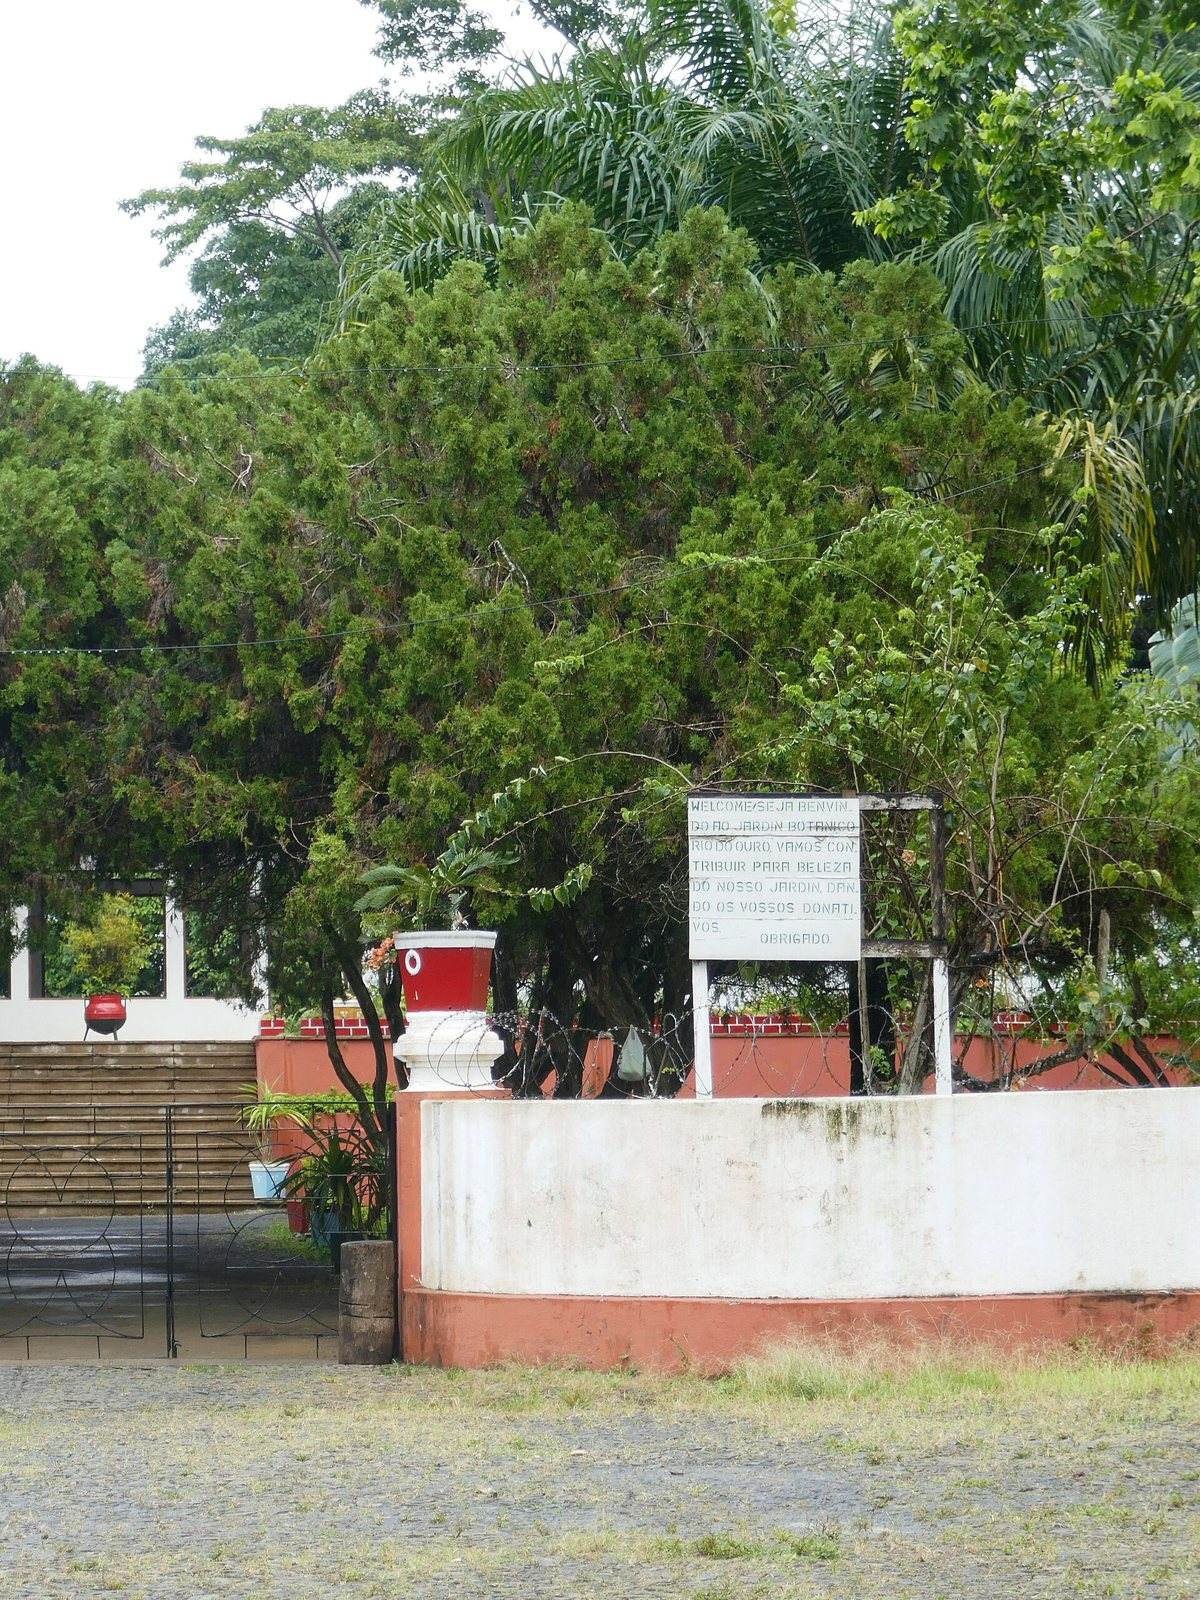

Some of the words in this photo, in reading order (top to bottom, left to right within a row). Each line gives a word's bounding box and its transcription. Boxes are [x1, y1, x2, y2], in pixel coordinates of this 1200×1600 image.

[691, 820, 708, 832] DO
[713, 820, 730, 832] AO
[734, 821, 782, 832] JARDIN
[776, 841, 821, 852] VAMOS
[693, 860, 746, 872] TRIBUIR
[754, 861, 790, 872] PARA
[798, 862, 851, 872] BELEZA
[693, 880, 710, 892] DO
[717, 881, 762, 892] NOSSO
[693, 902, 710, 912] DO
[716, 902, 734, 912] OS
[740, 902, 794, 913] VOSSOS
